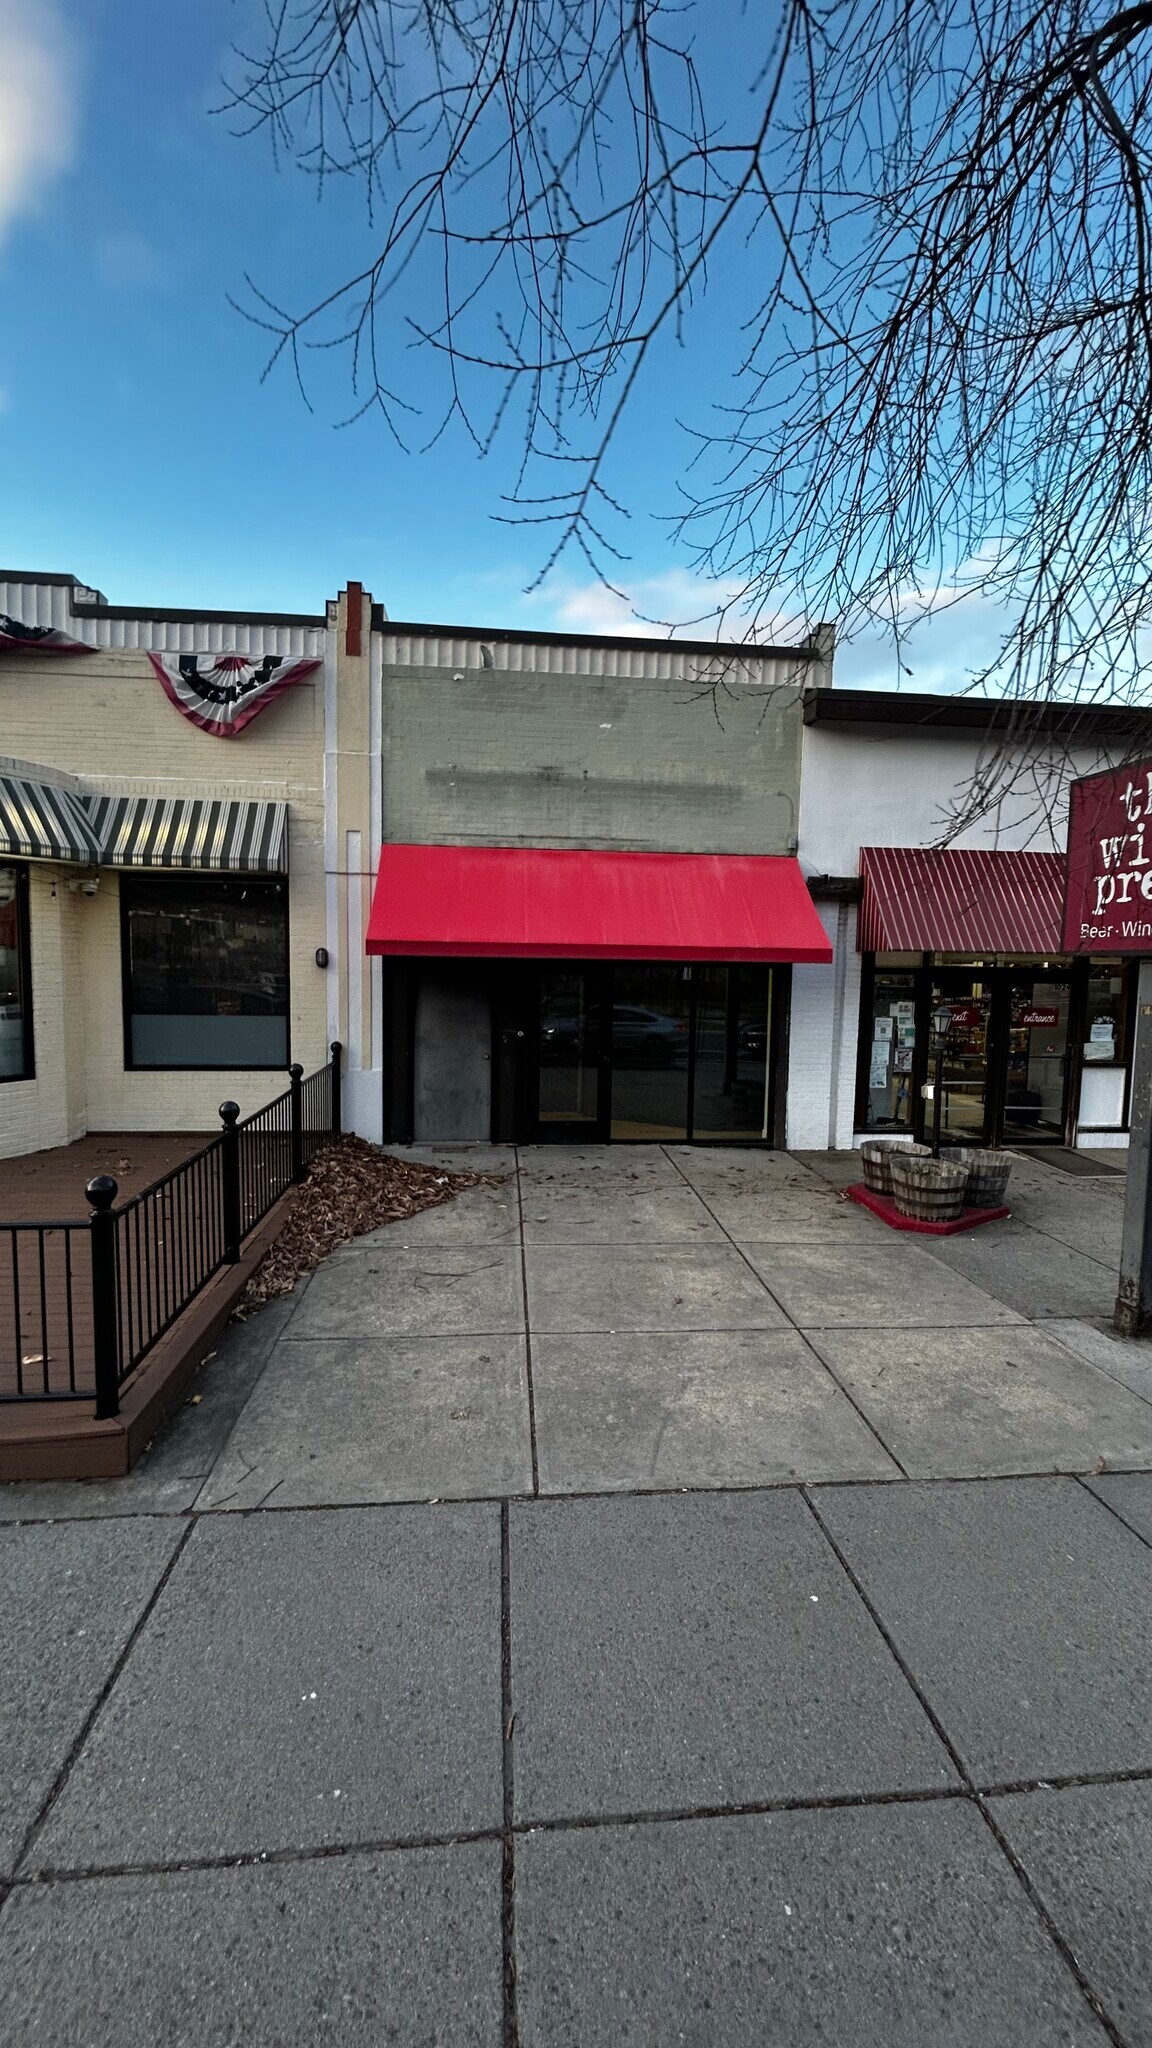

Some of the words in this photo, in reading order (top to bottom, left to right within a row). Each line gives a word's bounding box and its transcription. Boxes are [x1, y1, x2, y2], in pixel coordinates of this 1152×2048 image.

[1080, 923, 1114, 939] Beer
[952, 1010, 969, 1022] exit
[1023, 1011, 1056, 1023] entrance
